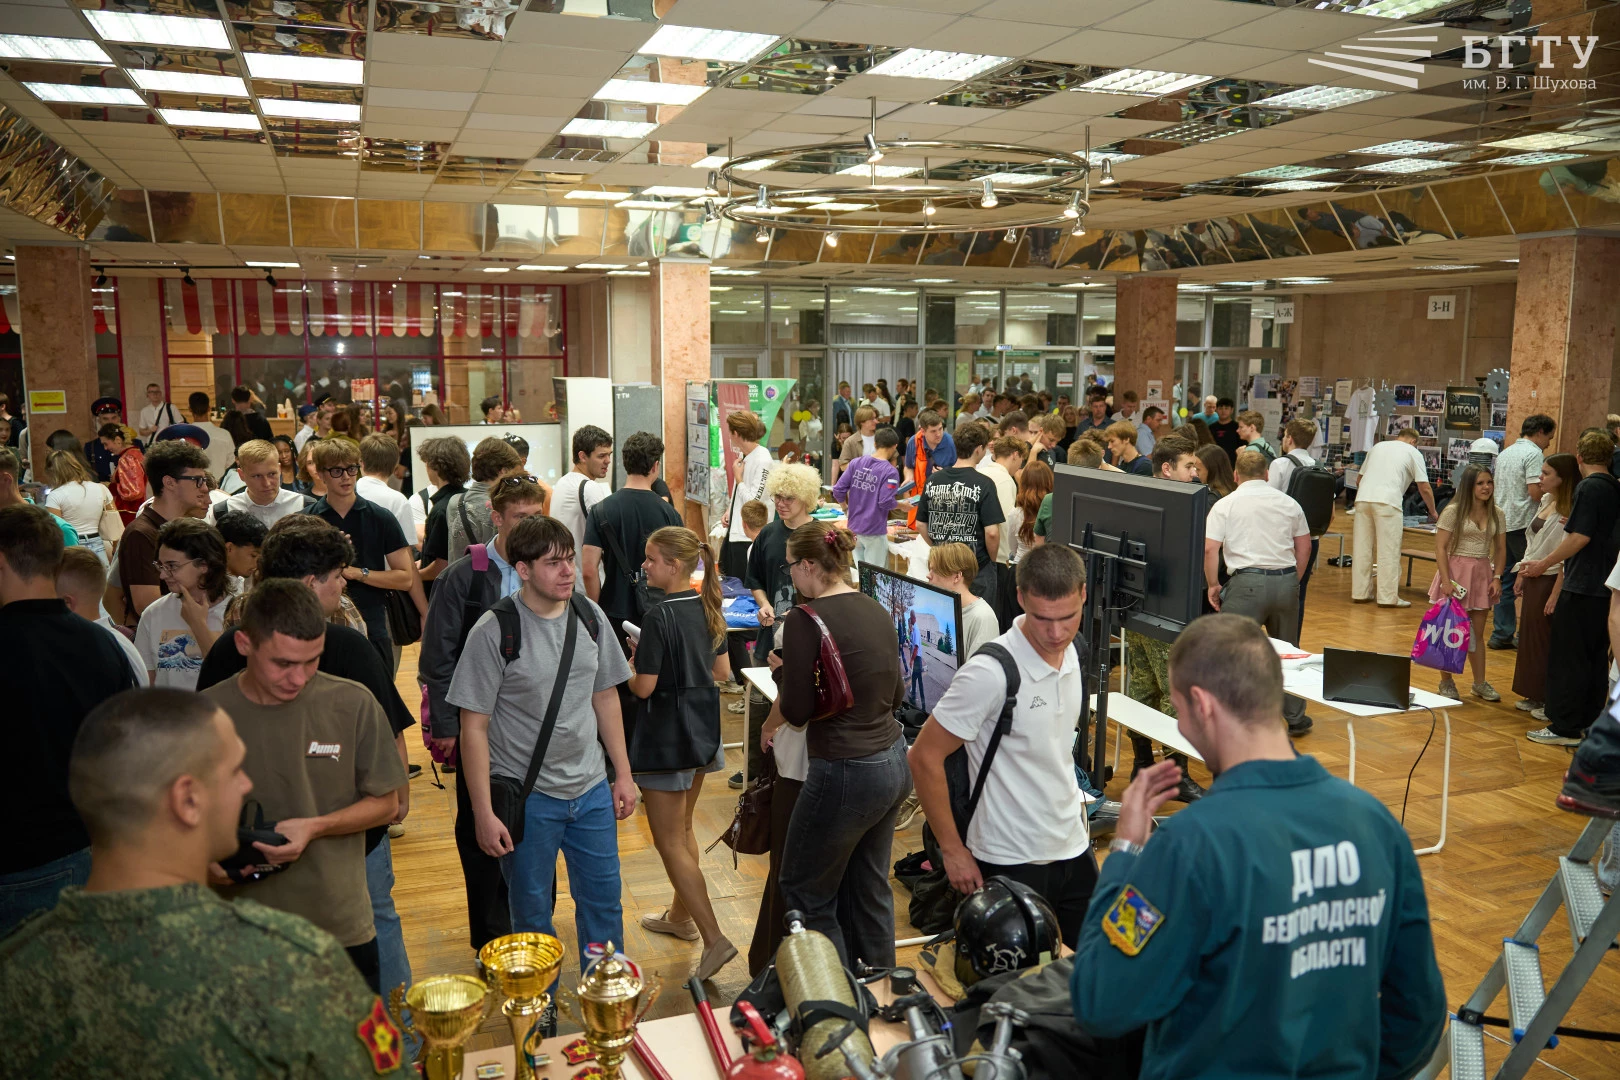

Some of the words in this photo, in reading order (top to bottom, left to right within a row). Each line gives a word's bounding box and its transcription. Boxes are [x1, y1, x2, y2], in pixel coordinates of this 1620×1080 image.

[1275, 307, 1293, 318] А-Ж
[1450, 404, 1479, 415] ИТОМ
[852, 469, 878, 484] ДЕЛАЮ
[851, 479, 876, 492] ДОБРО
[1423, 618, 1464, 649] wb
[308, 741, 341, 754] Puma
[1290, 840, 1361, 903] ДПО
